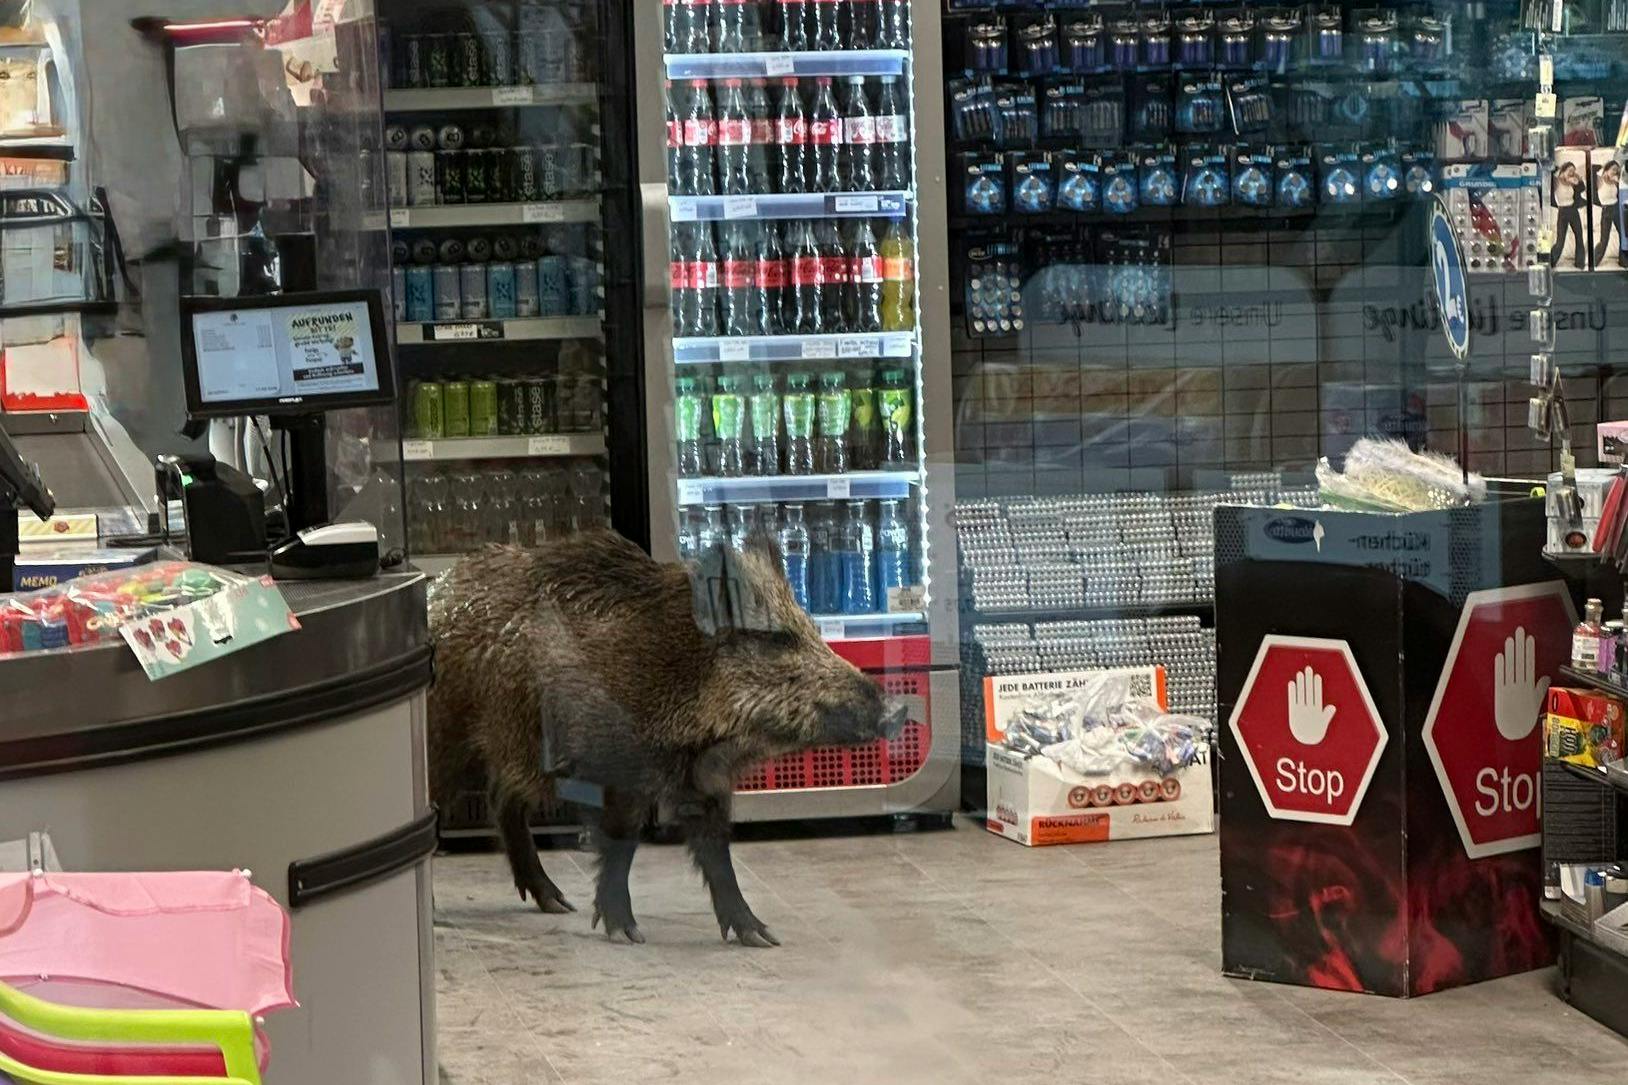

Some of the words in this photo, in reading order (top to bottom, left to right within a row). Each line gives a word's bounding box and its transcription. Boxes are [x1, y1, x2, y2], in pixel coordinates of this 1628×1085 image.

[292, 312, 353, 328] AUFRUNDEN
[998, 683, 1019, 692] JEDE
[1022, 680, 1063, 691] BATTERIE
[1276, 756, 1344, 804] Stop
